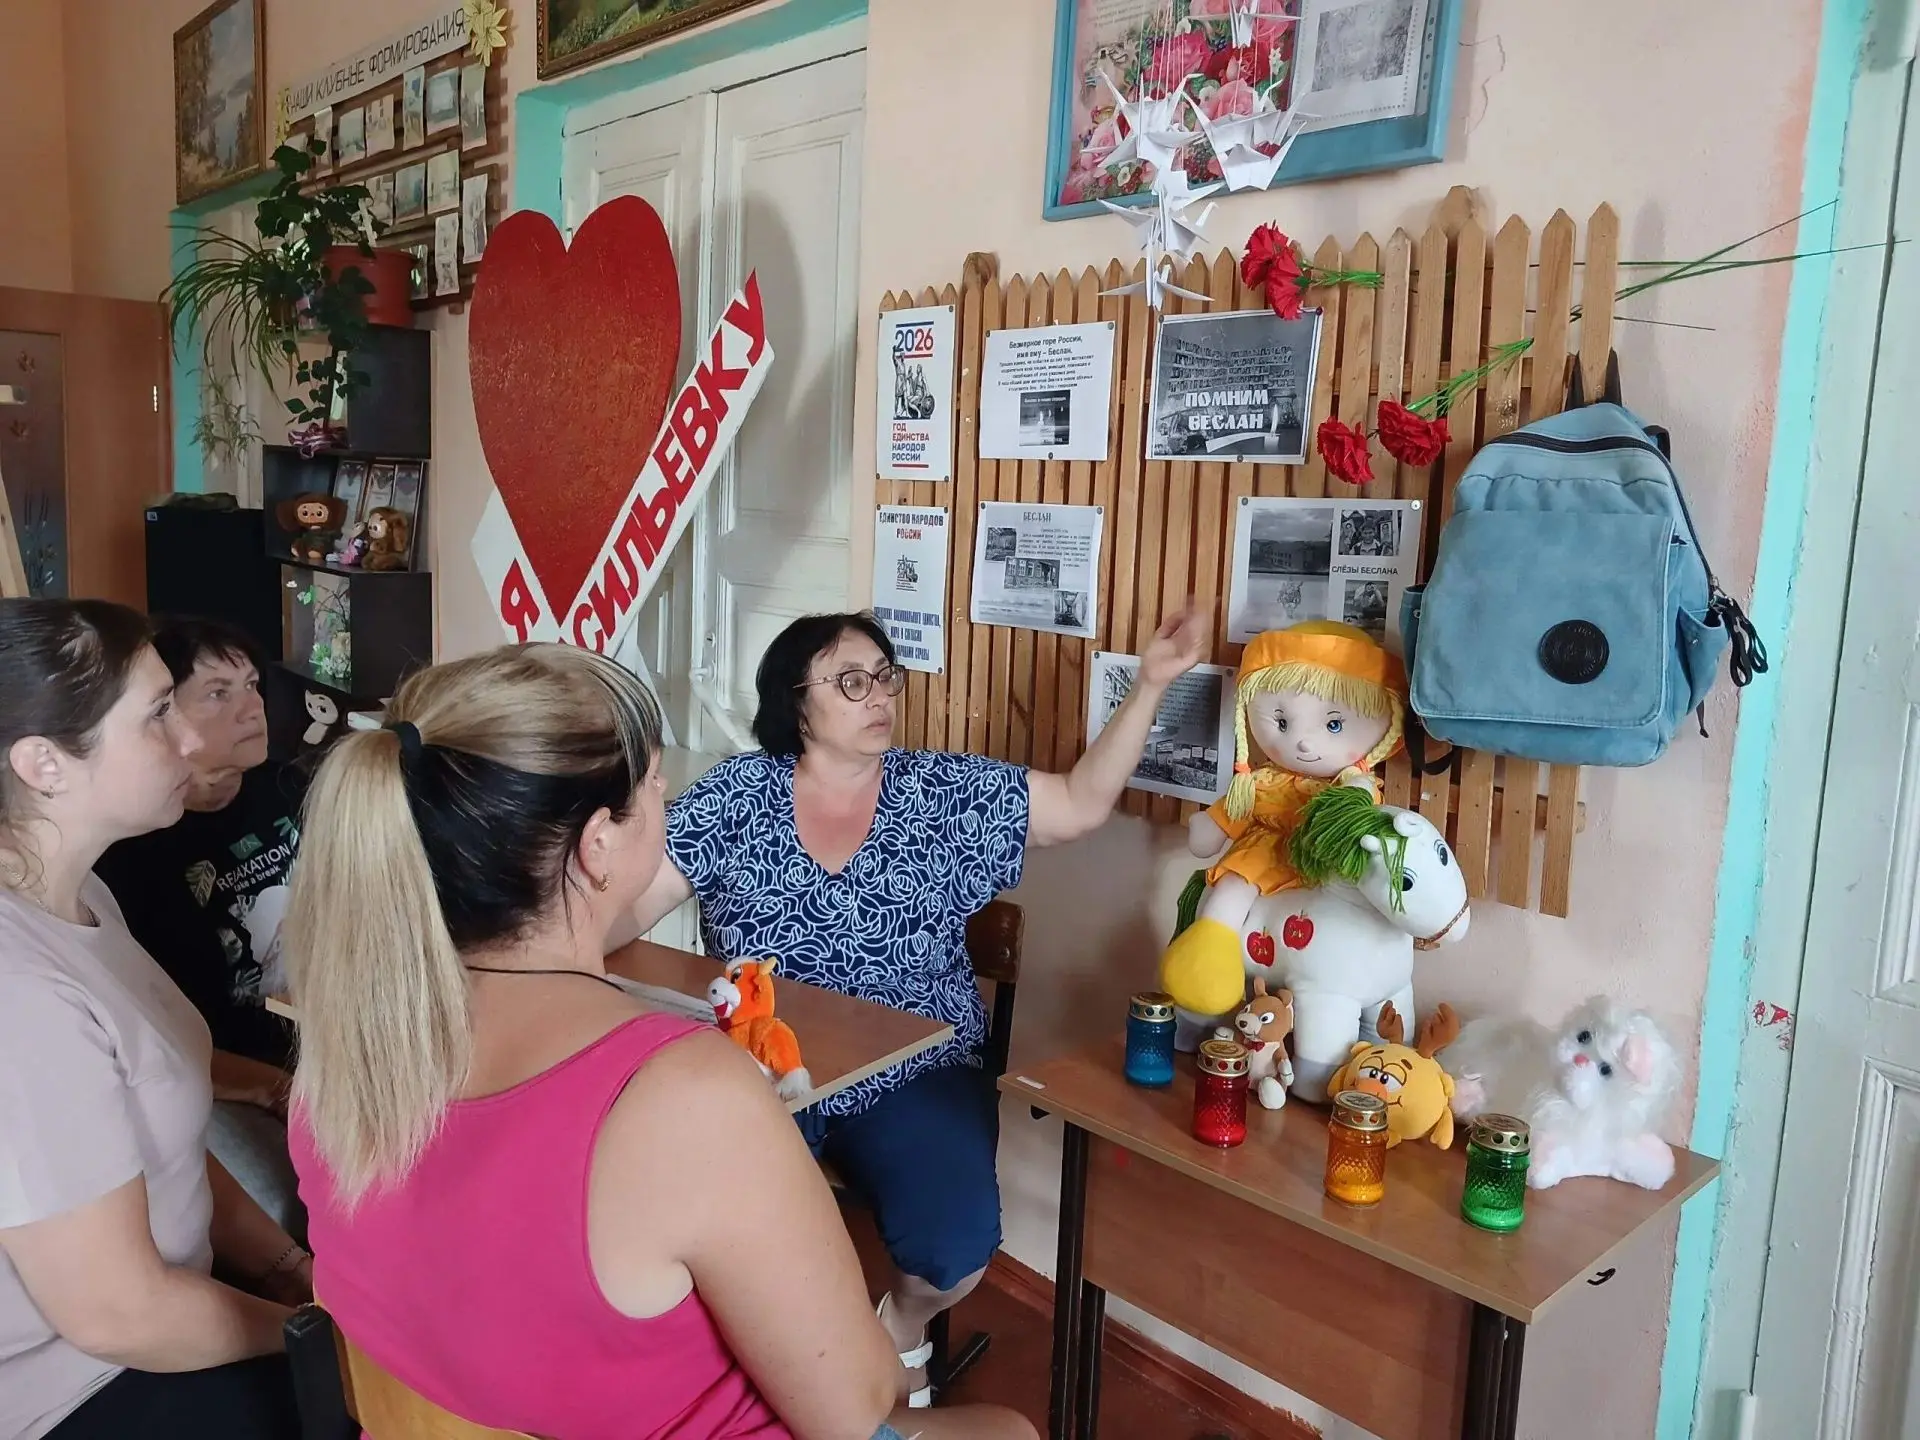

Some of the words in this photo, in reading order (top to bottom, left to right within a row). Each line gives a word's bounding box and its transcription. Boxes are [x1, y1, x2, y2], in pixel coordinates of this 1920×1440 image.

[290, 82, 314, 113] НАШИ
[316, 60, 365, 101] КЛУБНЫЕ
[369, 8, 466, 76] ФОРМИРОВАНИЯ
[895, 328, 934, 352] 2026
[1185, 389, 1269, 407] ПОМНИМ
[892, 423, 907, 433] ГОД
[1188, 413, 1264, 430] БЕСЛАН
[892, 433, 930, 442] ЕДИНСТВА
[891, 442, 926, 452] НАРОДОВ
[557, 267, 767, 655] СИЛЬЕВКУ
[891, 452, 921, 461] РОССИИ
[879, 512, 911, 525] ЕДИНСТВО
[911, 513, 944, 527] НАРОДОВ
[1023, 511, 1052, 522] БЕСЛАН
[896, 528, 922, 540] РОССИИ
[1331, 565, 1359, 574] СЛЁЗЫ
[1361, 566, 1399, 575] БЕСЛАНА
[500, 558, 541, 643] Я
[257, 864, 281, 881] break
